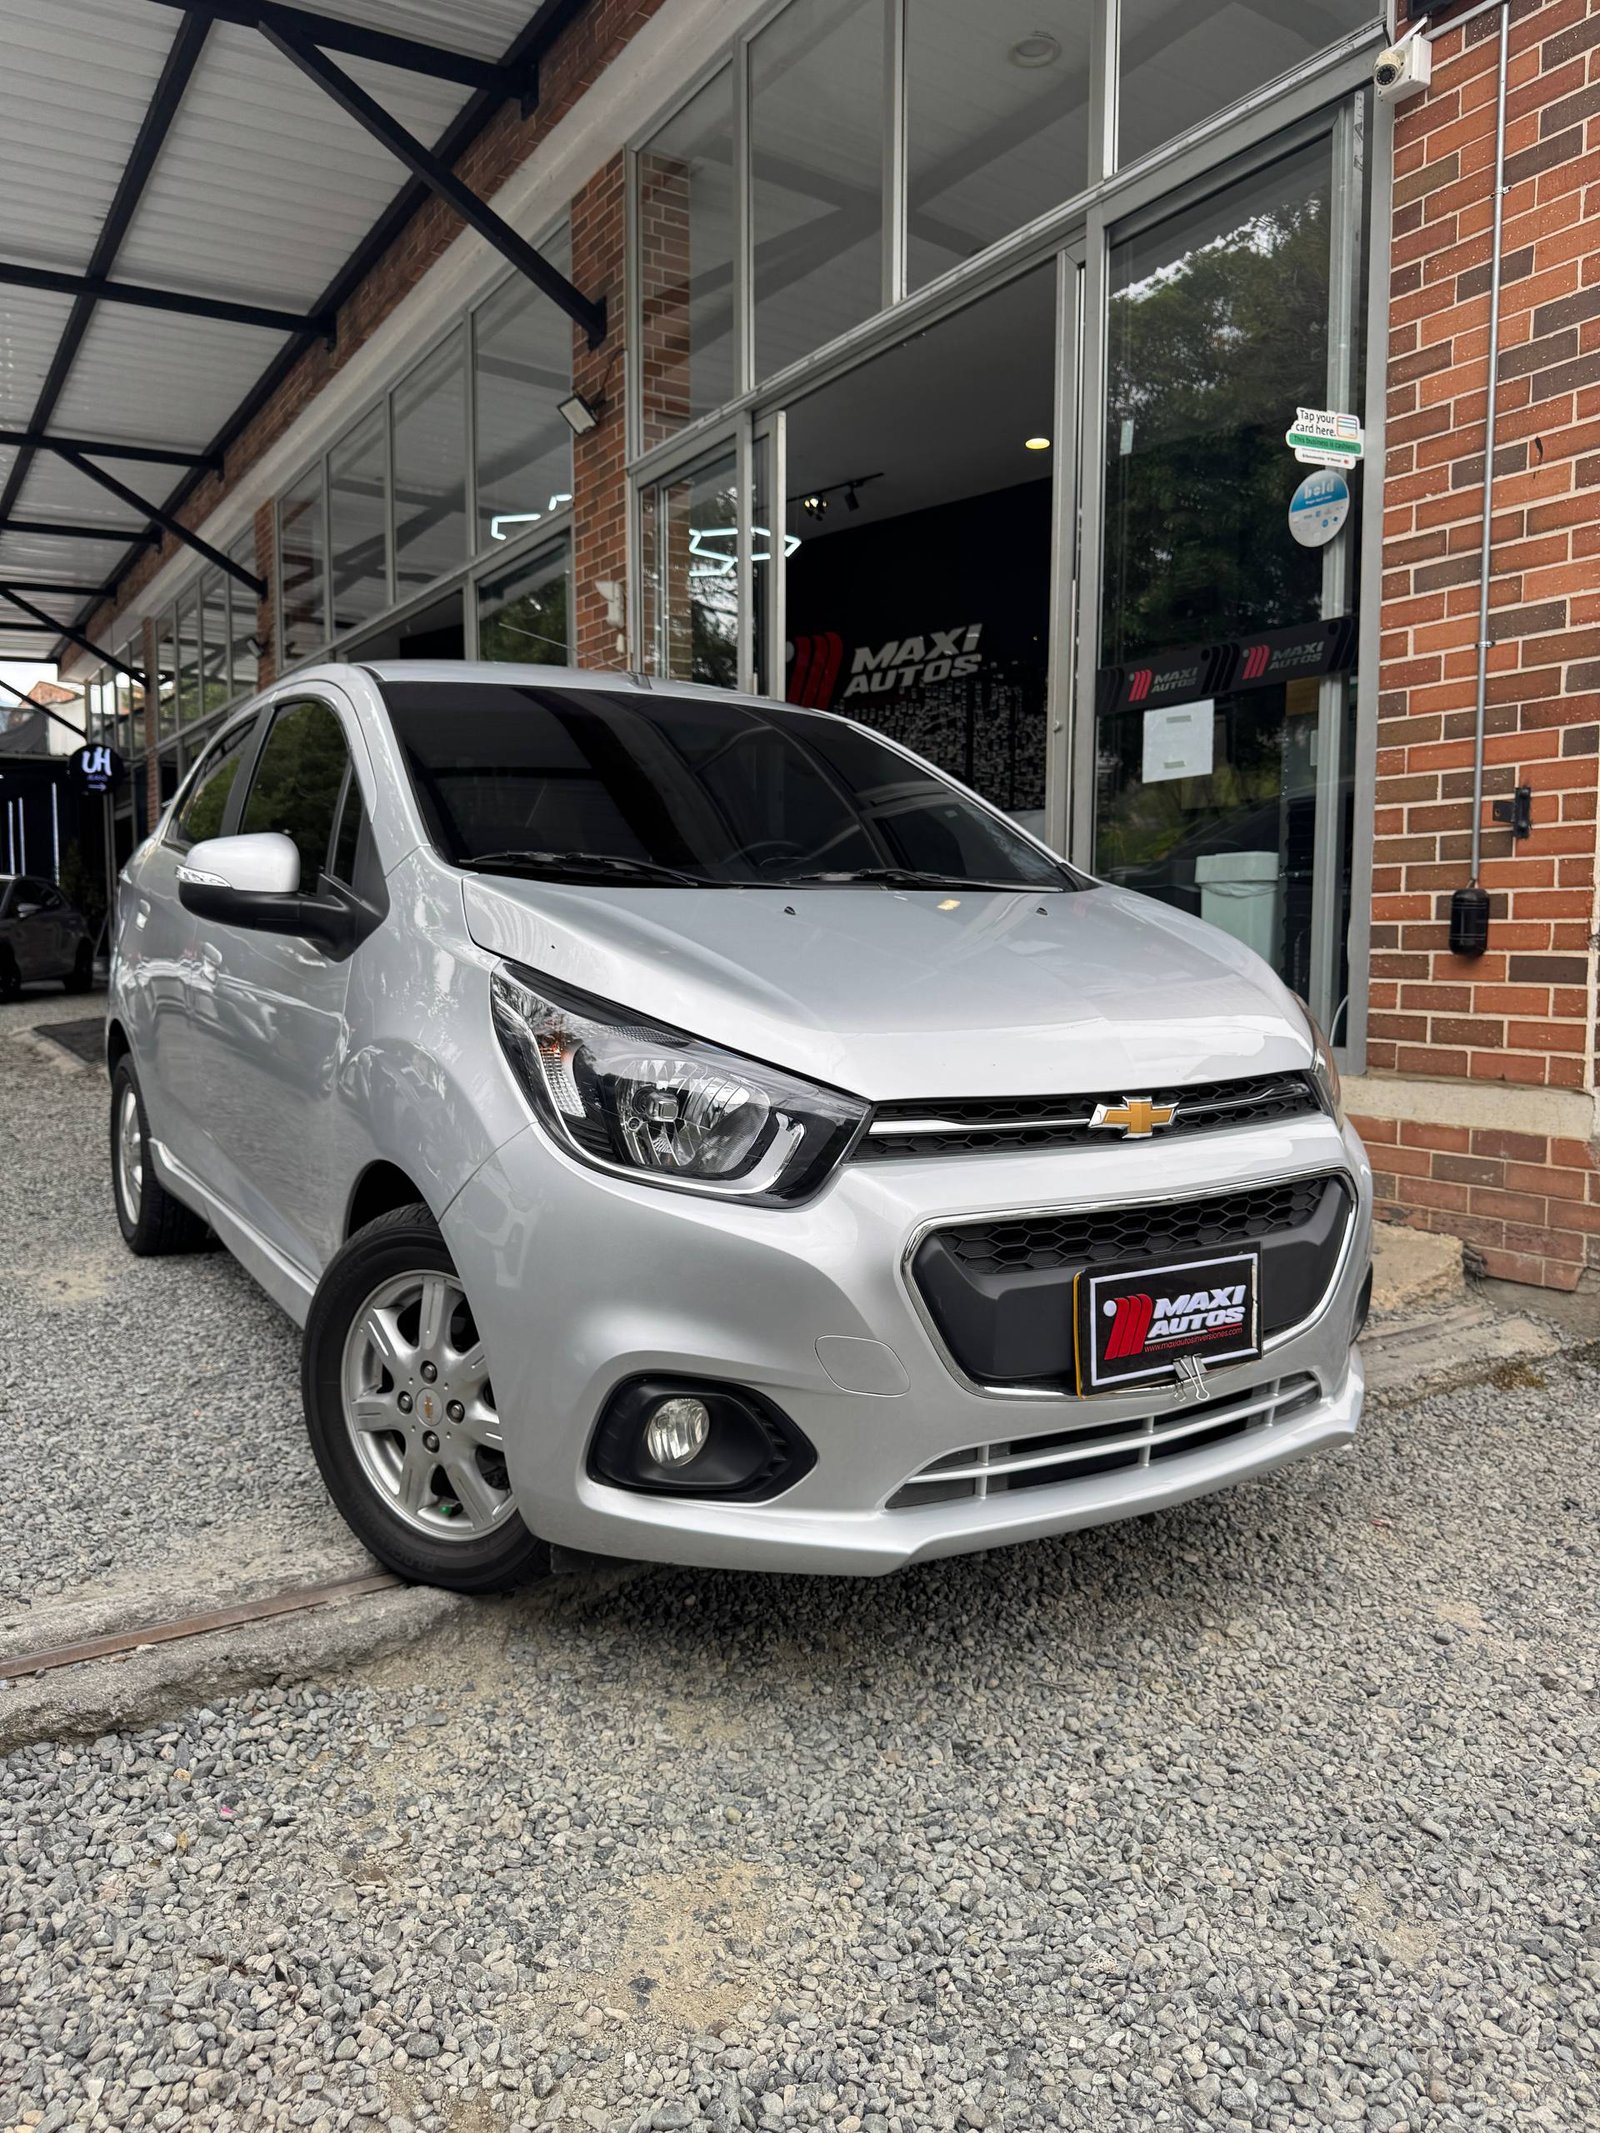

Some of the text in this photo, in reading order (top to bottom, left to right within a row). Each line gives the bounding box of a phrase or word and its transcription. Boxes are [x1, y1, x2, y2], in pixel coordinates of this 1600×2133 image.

[1300, 410, 1335, 424] Tap your
[1295, 423, 1336, 437] card here.
[1304, 480, 1334, 498] bold
[851, 623, 982, 674] MAXI
[1271, 641, 1325, 661] MAXI
[1268, 653, 1323, 671] AUTOS
[843, 653, 982, 698] AUTOS
[1151, 677, 1197, 693] AUTOS
[1154, 667, 1198, 684] MAXI
[1152, 1284, 1247, 1319] MAXI
[1147, 1306, 1246, 1338] AUTOS
[1144, 1327, 1243, 1353] www.maxiautosinversiones.com
